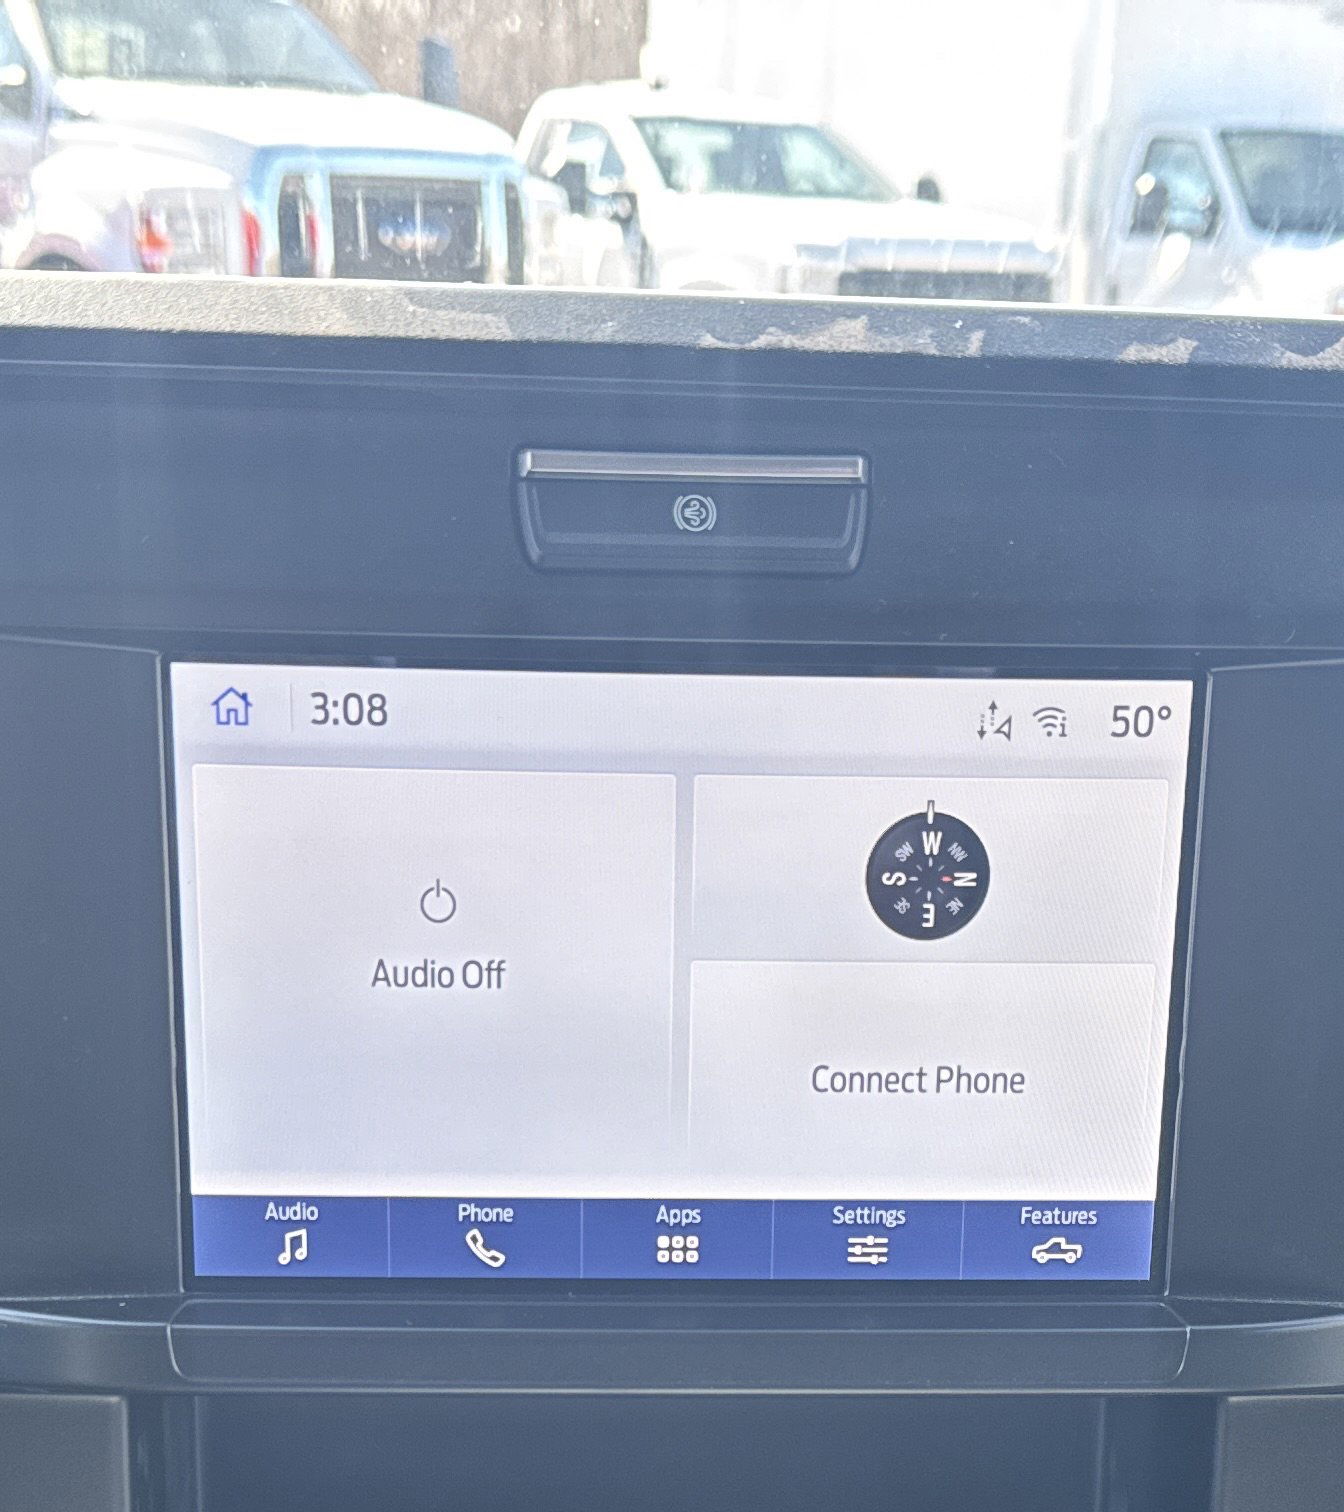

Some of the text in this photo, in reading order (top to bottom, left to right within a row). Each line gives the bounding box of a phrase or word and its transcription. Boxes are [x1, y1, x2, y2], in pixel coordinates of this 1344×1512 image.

[310, 691, 388, 727] 3:08
[1110, 705, 1172, 738] 50°
[894, 841, 914, 862] SW
[921, 830, 943, 856] W
[947, 842, 969, 863] NW
[881, 871, 907, 887] S
[953, 872, 978, 887] N
[921, 902, 936, 928] E
[371, 958, 506, 989] Audio Off
[812, 1064, 1025, 1094] Connect Phone
[263, 1201, 319, 1222] Audio
[458, 1202, 514, 1223] Phone
[655, 1205, 702, 1225] Apps
[832, 1205, 906, 1228] Settings
[1020, 1206, 1098, 1225] Features
